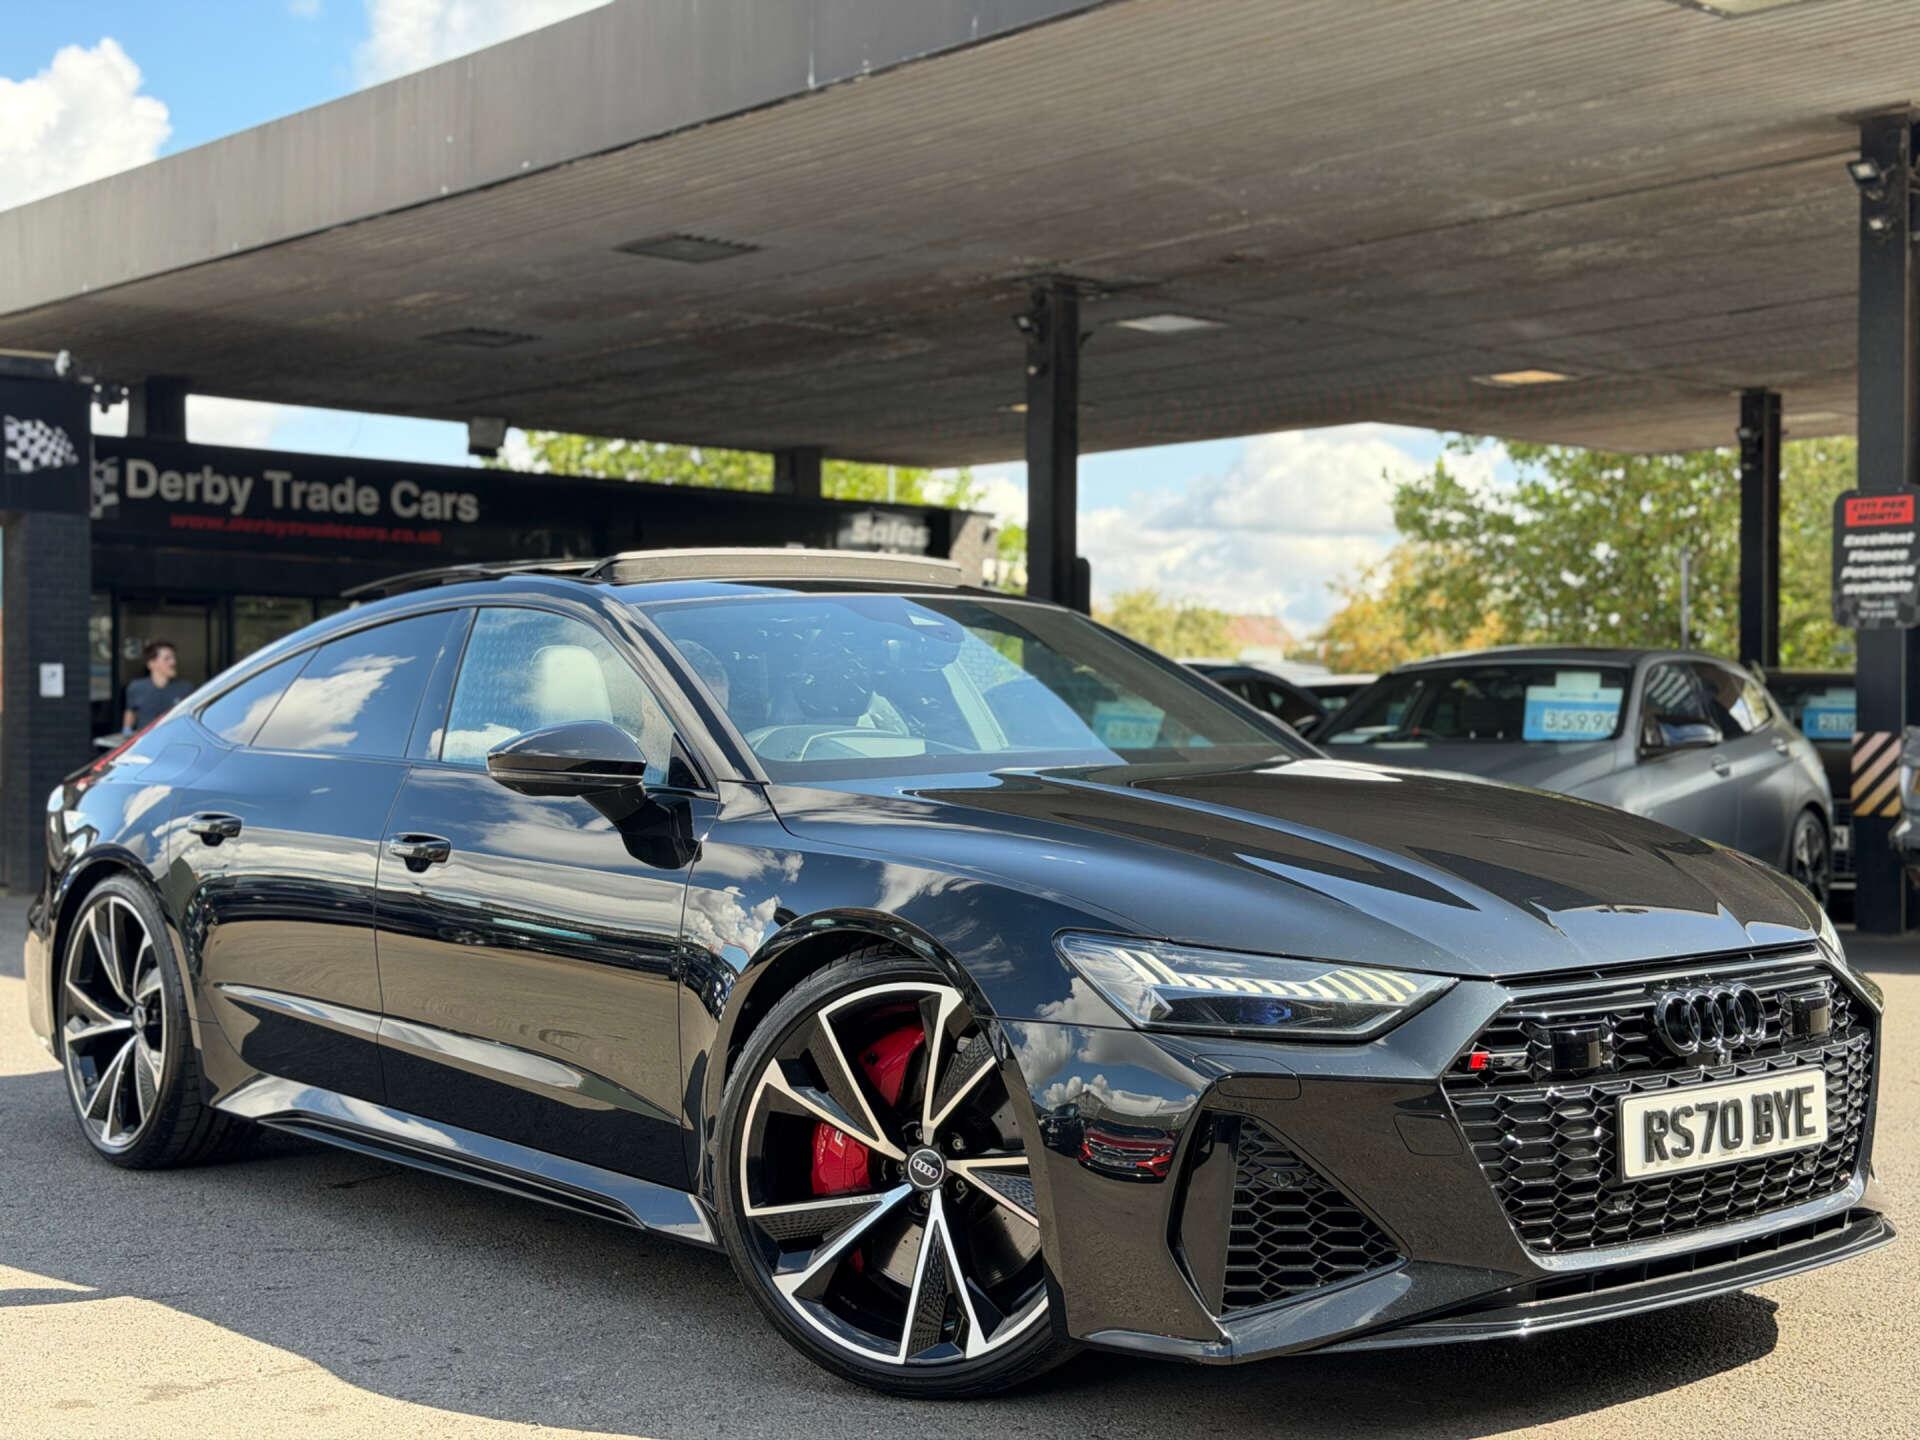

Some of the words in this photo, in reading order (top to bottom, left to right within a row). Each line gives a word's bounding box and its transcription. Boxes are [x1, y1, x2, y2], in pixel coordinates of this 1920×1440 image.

[126, 458, 254, 515] Derby
[263, 469, 380, 515] Trade
[390, 480, 480, 522] Cars
[852, 512, 931, 548] Sales
[1848, 548, 1909, 563] Finance
[1644, 1098, 1744, 1163] RS70
[1751, 1086, 1816, 1145] BYE
